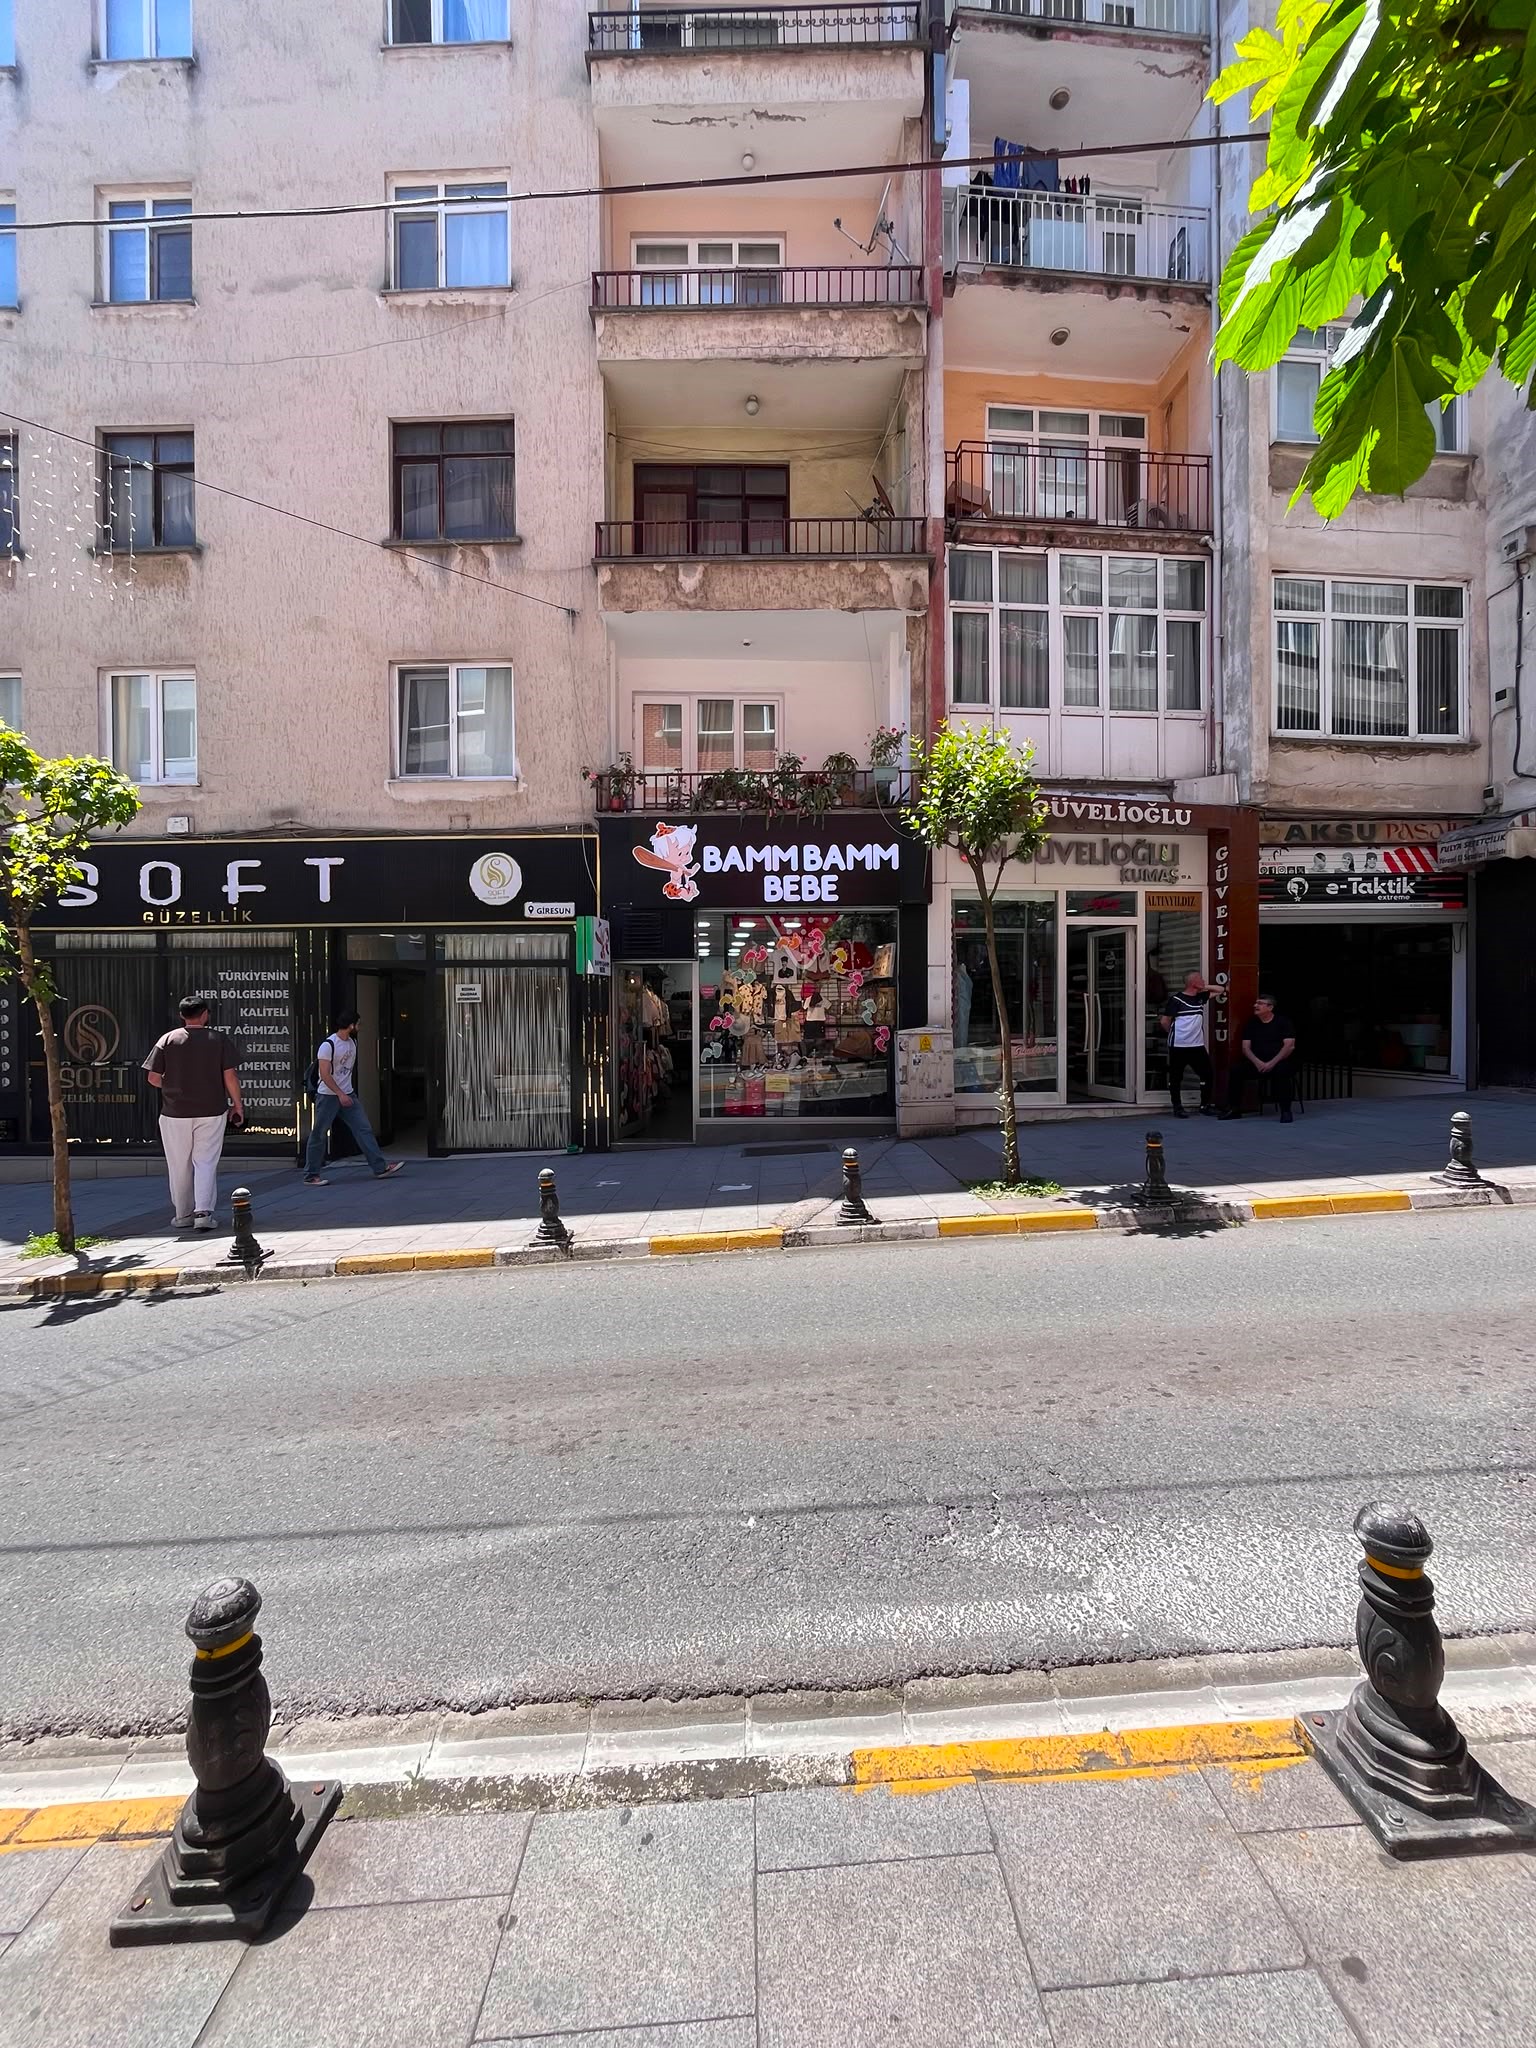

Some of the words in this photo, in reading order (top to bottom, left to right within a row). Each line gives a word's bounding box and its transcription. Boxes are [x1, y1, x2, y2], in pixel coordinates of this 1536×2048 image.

[1284, 823, 1377, 841] AKSU
[1439, 843, 1463, 854] FULYA
[703, 844, 799, 873] BAMM
[803, 843, 900, 871] BAMM
[57, 857, 345, 907] SOFT
[763, 874, 840, 902] BEBE
[1325, 876, 1416, 896] e-Taktik
[1146, 894, 1197, 908] ALTINYILDIZ
[142, 906, 253, 924] GÜZELLİK
[536, 906, 571, 915] GİRESUN
[218, 970, 289, 981] TÜRKİYENİN
[195, 989, 218, 999] HER
[220, 987, 290, 999] BÖLGESİNDE
[240, 1006, 289, 1017] KALİTELİ
[234, 1023, 290, 1035] AĞIMIZLA
[246, 1041, 290, 1053] SİZLERE
[235, 1061, 291, 1071] TMEKTEN
[59, 1067, 129, 1089] SOFT
[239, 1079, 292, 1089] UTLULUK
